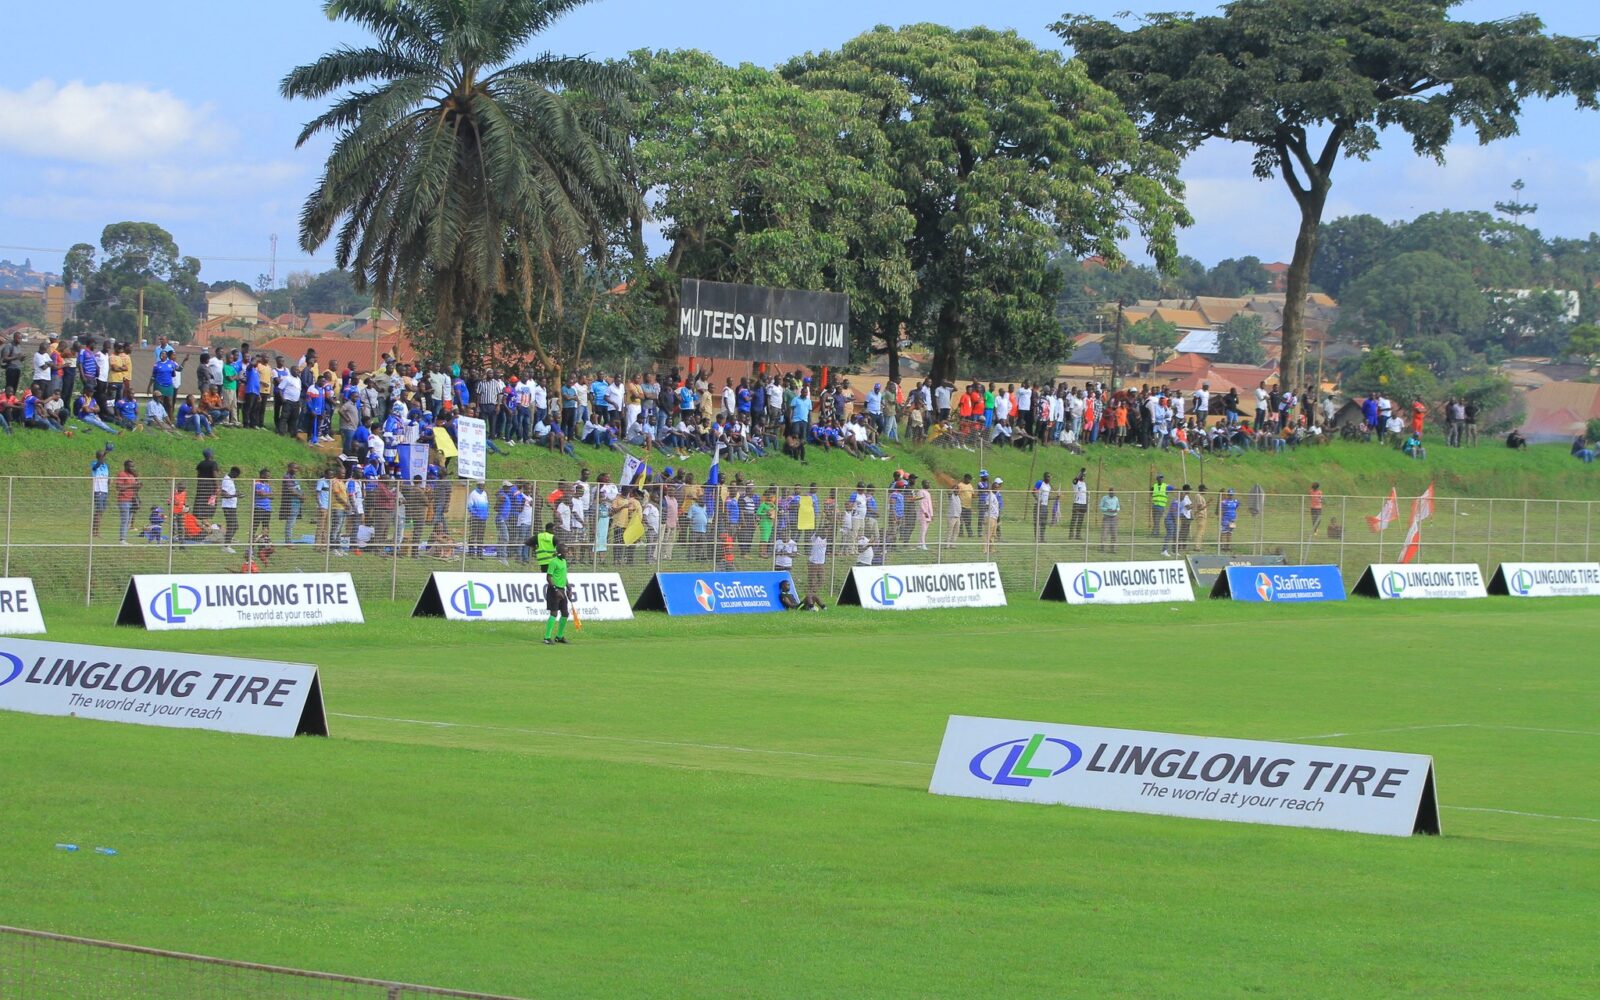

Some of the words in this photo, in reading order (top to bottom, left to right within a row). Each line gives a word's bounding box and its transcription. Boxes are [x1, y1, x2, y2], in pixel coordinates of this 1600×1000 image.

[680, 307, 756, 342] MUTEESA
[773, 318, 844, 348] STADIUM
[905, 574, 965, 593] LINGLONG
[967, 571, 997, 590] TIRE
[1103, 569, 1157, 587] LINGLONG
[1158, 568, 1185, 585] TIRE
[1273, 574, 1321, 591] StarTimes
[1406, 571, 1455, 587] LINGLONG
[1455, 571, 1479, 587] TIRE
[1533, 569, 1577, 585] LINGLONG
[1578, 569, 1600, 584] TIRE
[205, 584, 300, 607] LINGLONG
[303, 583, 349, 605] TIRE
[580, 582, 620, 603] TIRE
[714, 581, 767, 599] StarTimes
[237, 610, 252, 620] The
[253, 609, 275, 620] world
[275, 610, 283, 619] at
[284, 610, 302, 622] your
[303, 608, 323, 620] reach
[526, 606, 539, 615] The
[25, 656, 202, 698] LINGLONG
[206, 673, 298, 708] TIRE
[68, 693, 93, 708] The
[95, 694, 134, 711] world
[135, 700, 151, 713] at
[149, 703, 183, 718] your
[184, 706, 223, 721] reach
[1085, 742, 1295, 788] LINGLONG
[1298, 760, 1410, 799] TIRE
[1139, 781, 1168, 798] The
[1171, 783, 1219, 804] world
[1219, 790, 1237, 805] at
[1236, 793, 1279, 810] your
[1279, 795, 1325, 814] reach
